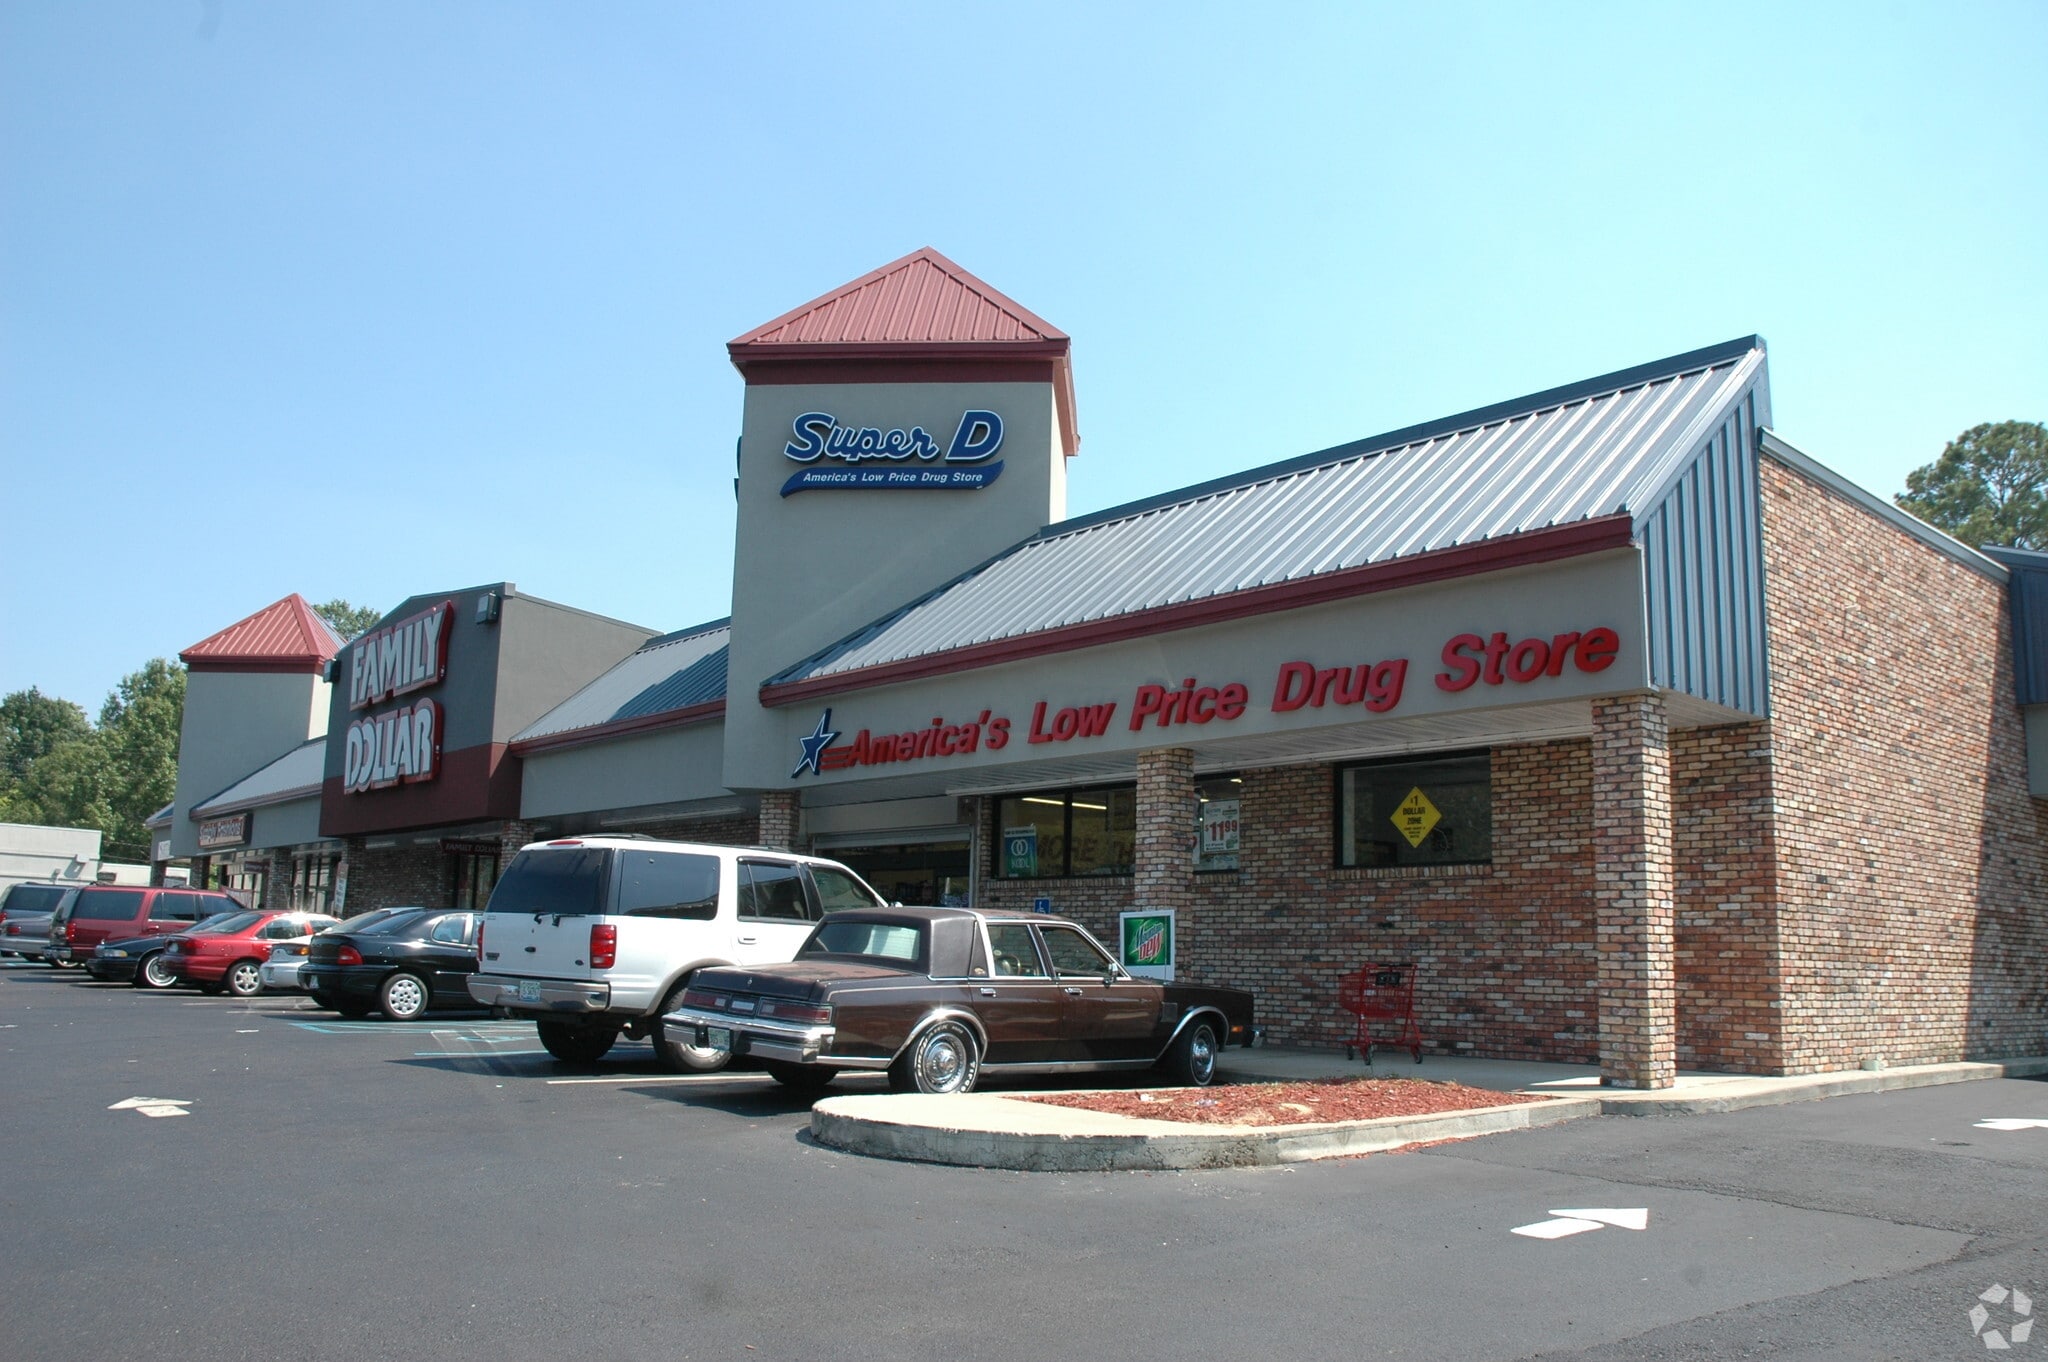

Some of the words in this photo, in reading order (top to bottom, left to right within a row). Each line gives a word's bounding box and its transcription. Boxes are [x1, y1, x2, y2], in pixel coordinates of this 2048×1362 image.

[784, 411, 940, 462] Super
[945, 410, 1004, 463] D
[803, 471, 857, 482] America's
[861, 472, 884, 482] Low
[889, 471, 916, 482] Price
[921, 471, 948, 484] Drug
[952, 472, 983, 482] Store
[351, 611, 443, 705] FAMILY
[845, 709, 1010, 768] America's
[1028, 701, 1116, 744] Low
[1129, 678, 1248, 731] Price
[1272, 658, 1408, 713] Drug
[1434, 627, 1620, 693] Store
[345, 707, 433, 788] DOLLAR
